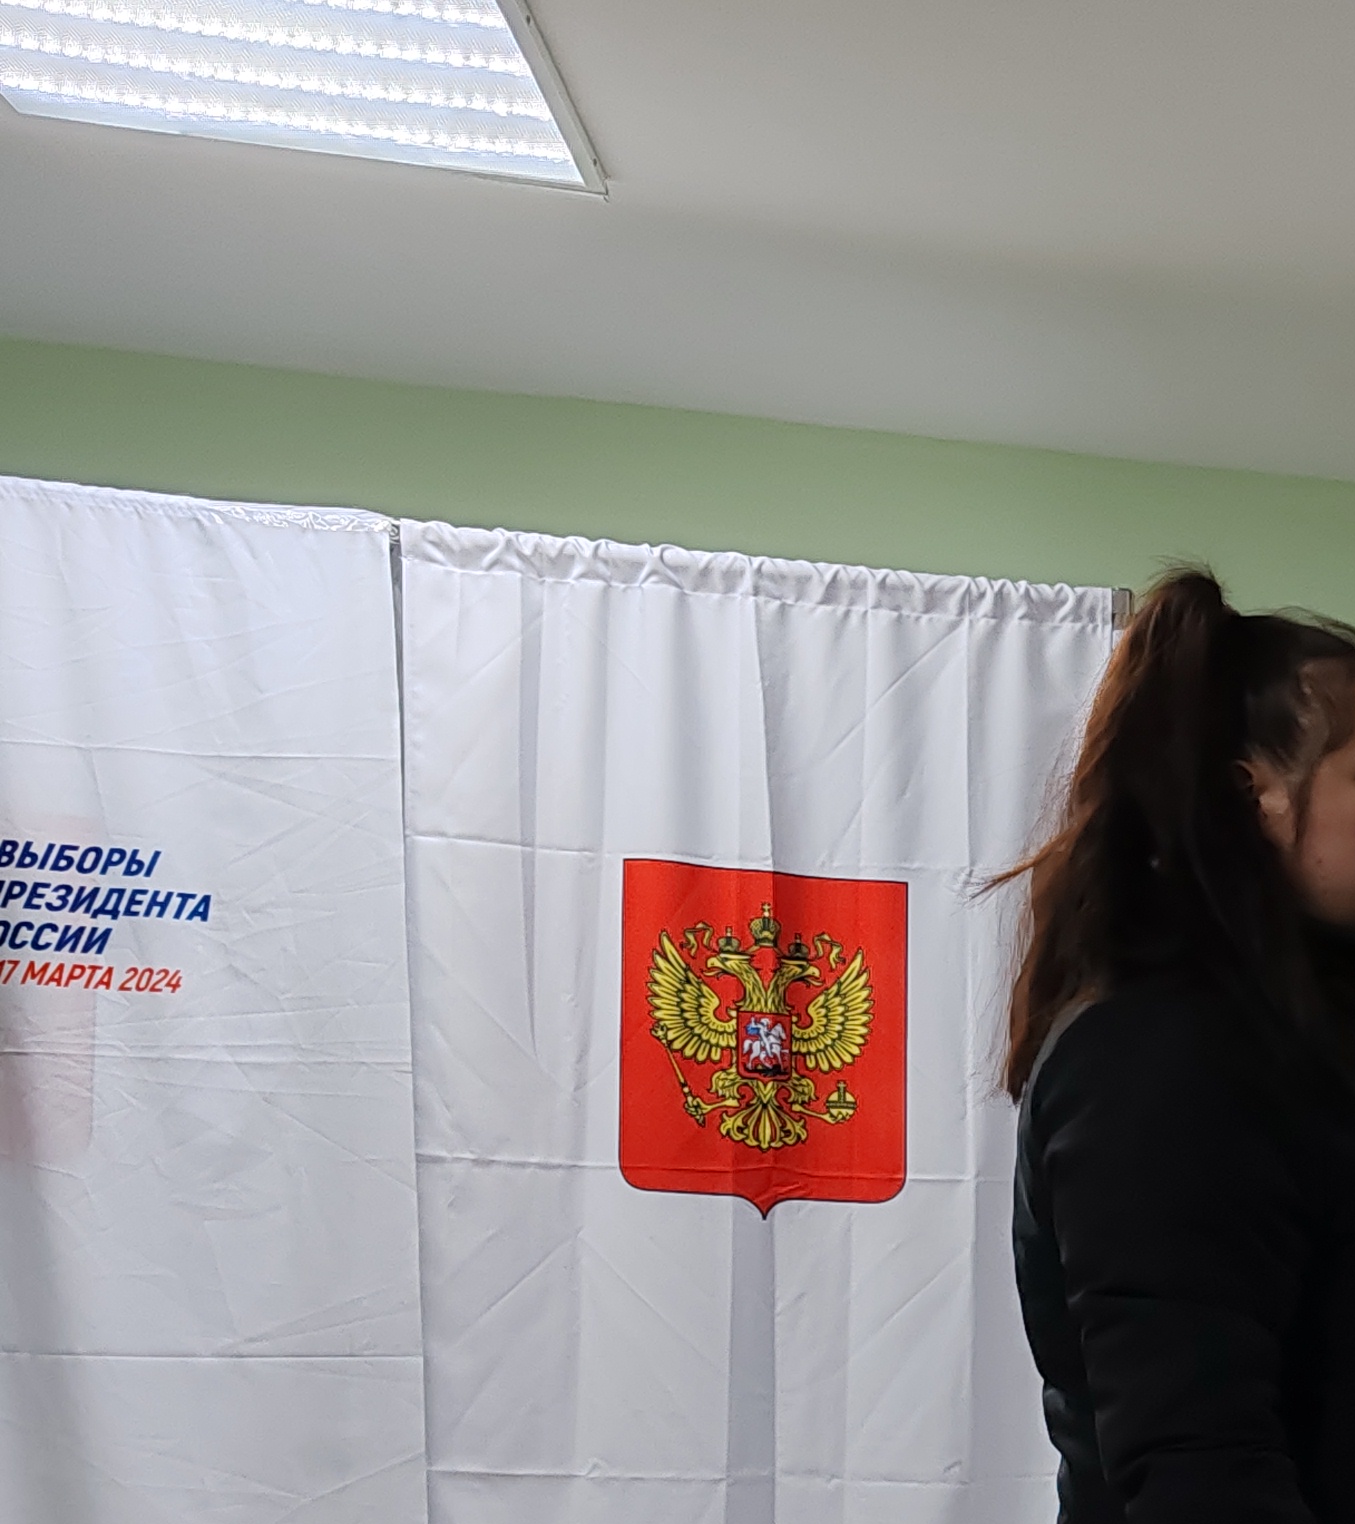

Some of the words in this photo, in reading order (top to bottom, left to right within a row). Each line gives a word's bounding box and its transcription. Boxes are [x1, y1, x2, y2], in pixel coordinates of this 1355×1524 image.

[0, 839, 162, 878] ВЫБОРЫ
[20, 960, 114, 991] МАРТА
[118, 967, 183, 994] 2024
